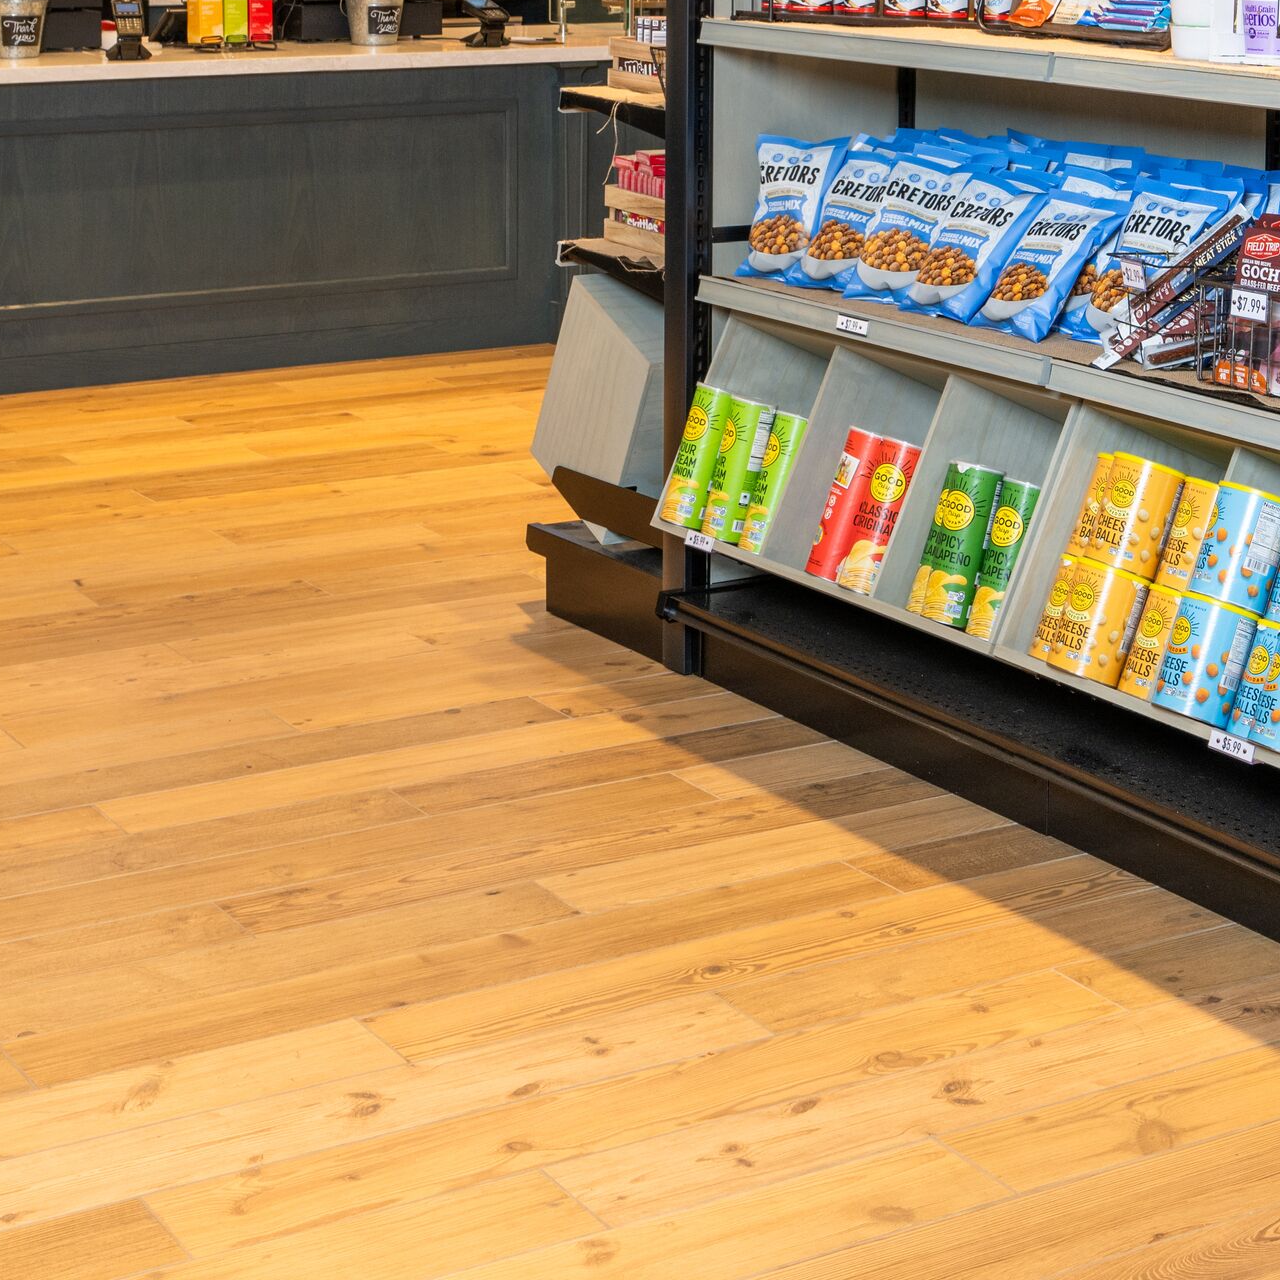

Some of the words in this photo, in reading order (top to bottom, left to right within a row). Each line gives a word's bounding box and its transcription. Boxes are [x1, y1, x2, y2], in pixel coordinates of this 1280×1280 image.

[370, 8, 400, 23] Thank
[3, 18, 37, 33] Thank
[376, 23, 399, 34] you
[11, 33, 36, 45] you
[760, 164, 820, 185] CRETORS
[887, 181, 956, 212] CRETORS
[785, 199, 802, 211] MIX
[950, 201, 1014, 227] CRETORS
[908, 220, 933, 234] MIX
[1027, 221, 1087, 241] CRETORS
[1124, 214, 1191, 243] CRETORS
[961, 234, 982, 249] MIX
[1246, 241, 1266, 252] FIELD
[1268, 242, 1280, 251] TRIP
[1195, 251, 1216, 269] MEAT
[1216, 233, 1238, 254] STICK
[1241, 279, 1266, 290] GRASS-FED
[1267, 283, 1280, 293] BEEF
[1236, 296, 1261, 314] $7.99
[845, 319, 858, 331] $7.99
[874, 473, 903, 488] GOOD
[1114, 486, 1134, 497] GOOD
[946, 501, 972, 514] GOOD
[1074, 589, 1092, 600] GOOD
[1055, 633, 1083, 650] BALLS
[1221, 735, 1242, 755] $5.99
